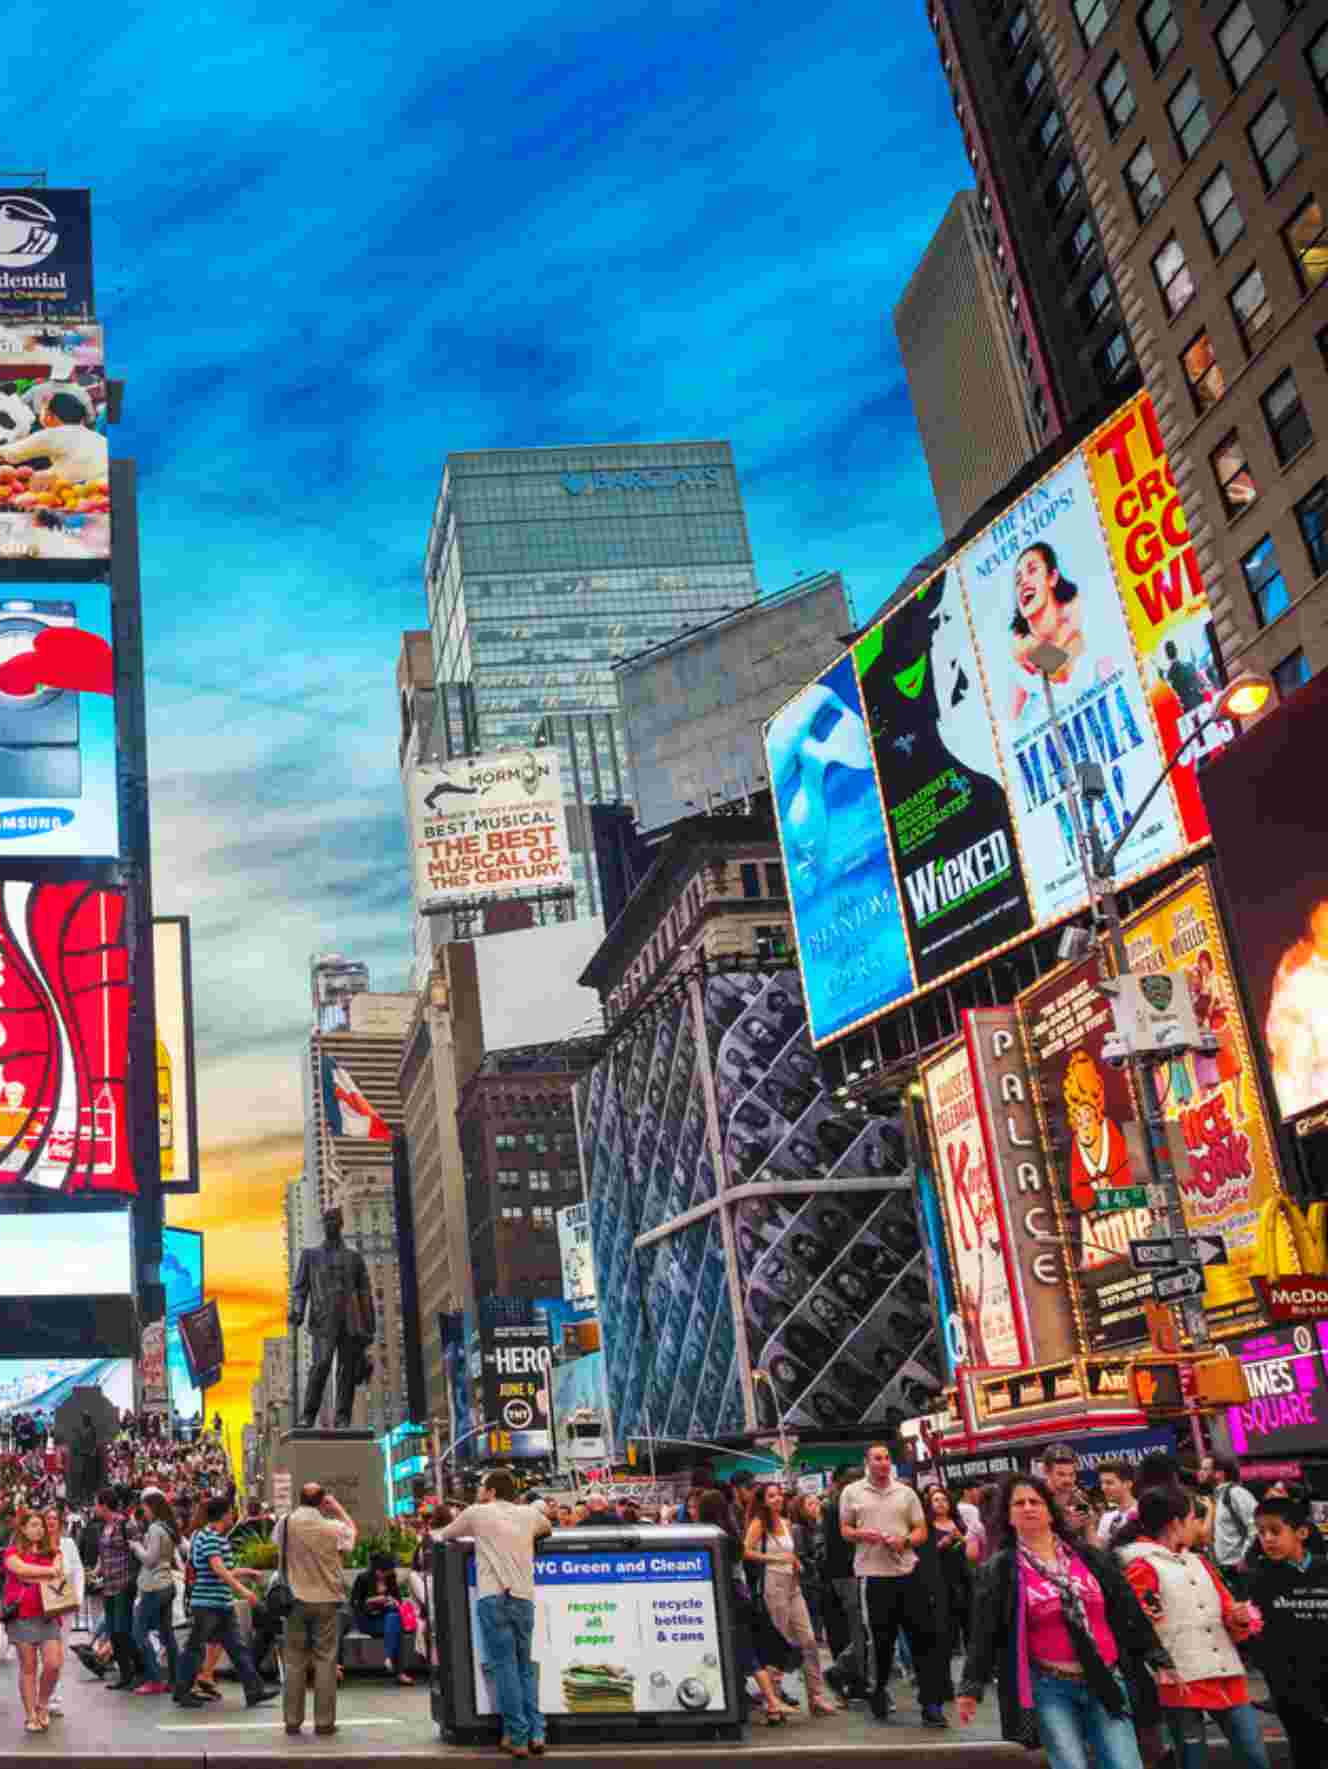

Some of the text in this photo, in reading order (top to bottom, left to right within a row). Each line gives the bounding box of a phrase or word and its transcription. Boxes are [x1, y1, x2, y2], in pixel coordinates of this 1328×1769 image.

[591, 466, 720, 493] BARCLAYS
[1016, 683, 1145, 815] MAMMA
[424, 811, 554, 839] BEST MUSICAL
[487, 826, 556, 851] BEST
[428, 846, 559, 876] MUSICAL OF
[431, 874, 471, 889] THIS
[992, 1030, 1062, 1285] PALACE
[1082, 1204, 1154, 1275] Annie
[497, 1346, 552, 1374] HERO
[1242, 1359, 1294, 1397] IMES
[509, 1408, 529, 1421] TNT
[1240, 1392, 1317, 1434] SQUARE
[561, 1561, 611, 1574] Green
[616, 1557, 645, 1573] and
[650, 1557, 703, 1573] Clean!
[567, 1599, 617, 1613] recycle
[652, 1598, 704, 1612] recycle
[655, 1614, 704, 1627] bottles
[574, 1635, 615, 1646] paper
[657, 1631, 705, 1643] & cans
